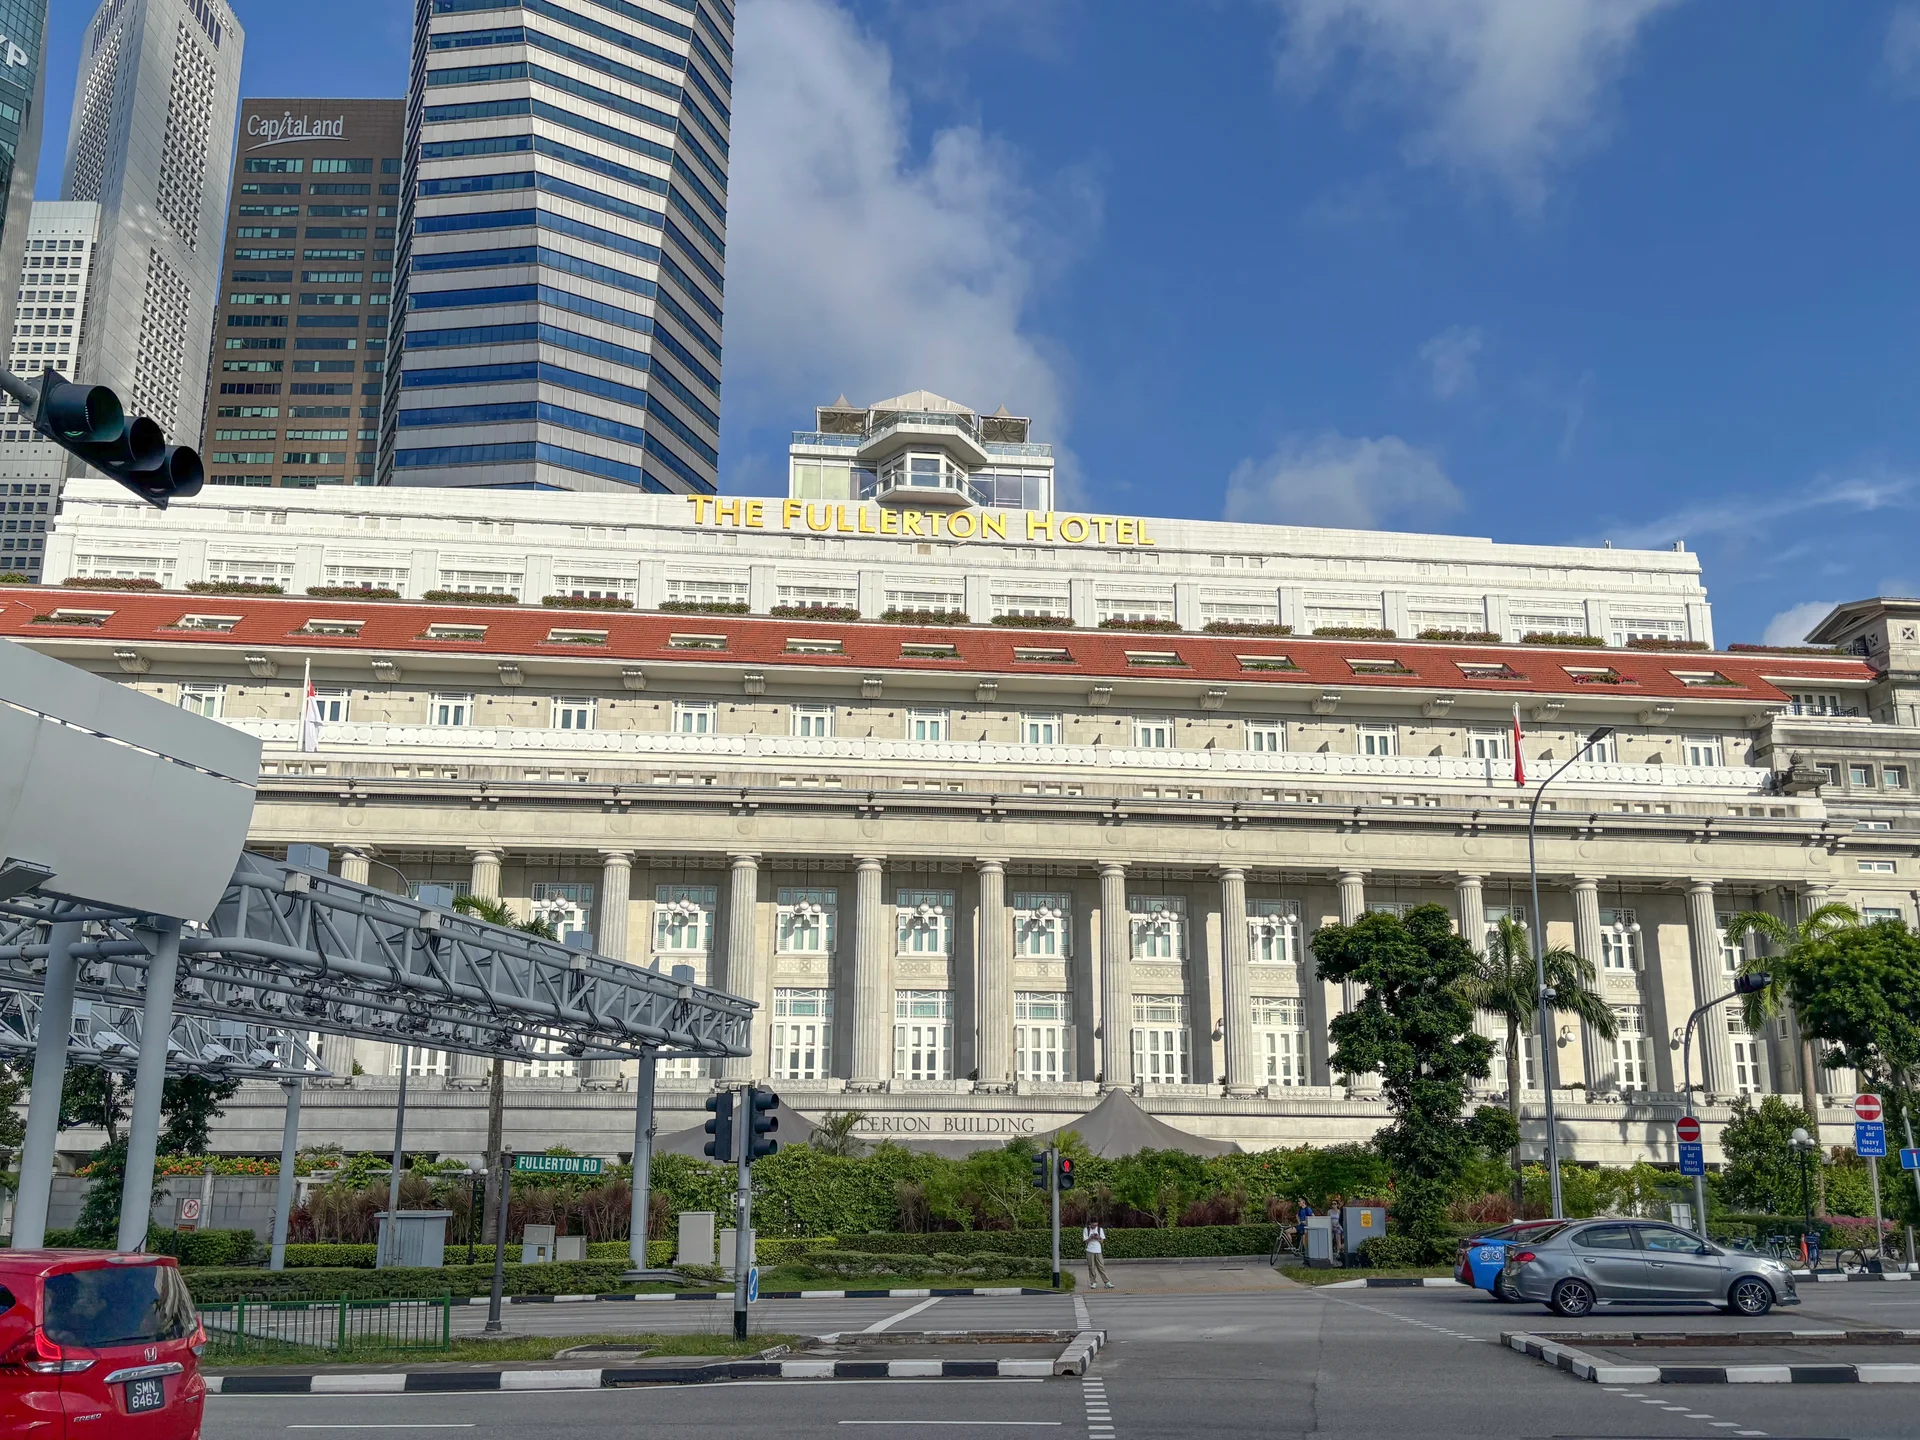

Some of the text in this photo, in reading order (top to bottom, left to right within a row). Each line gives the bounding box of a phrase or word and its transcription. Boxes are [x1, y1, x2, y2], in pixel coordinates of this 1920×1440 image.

[0, 34, 28, 67] P
[247, 111, 344, 141] CapitaLand
[687, 494, 1155, 545] THE FULLERTON HOTEL
[944, 1117, 1034, 1132] BUILDING
[519, 1156, 597, 1172] FULLERTON RD
[135, 1381, 156, 1396] SMN
[132, 1392, 161, 1408] 846Z
